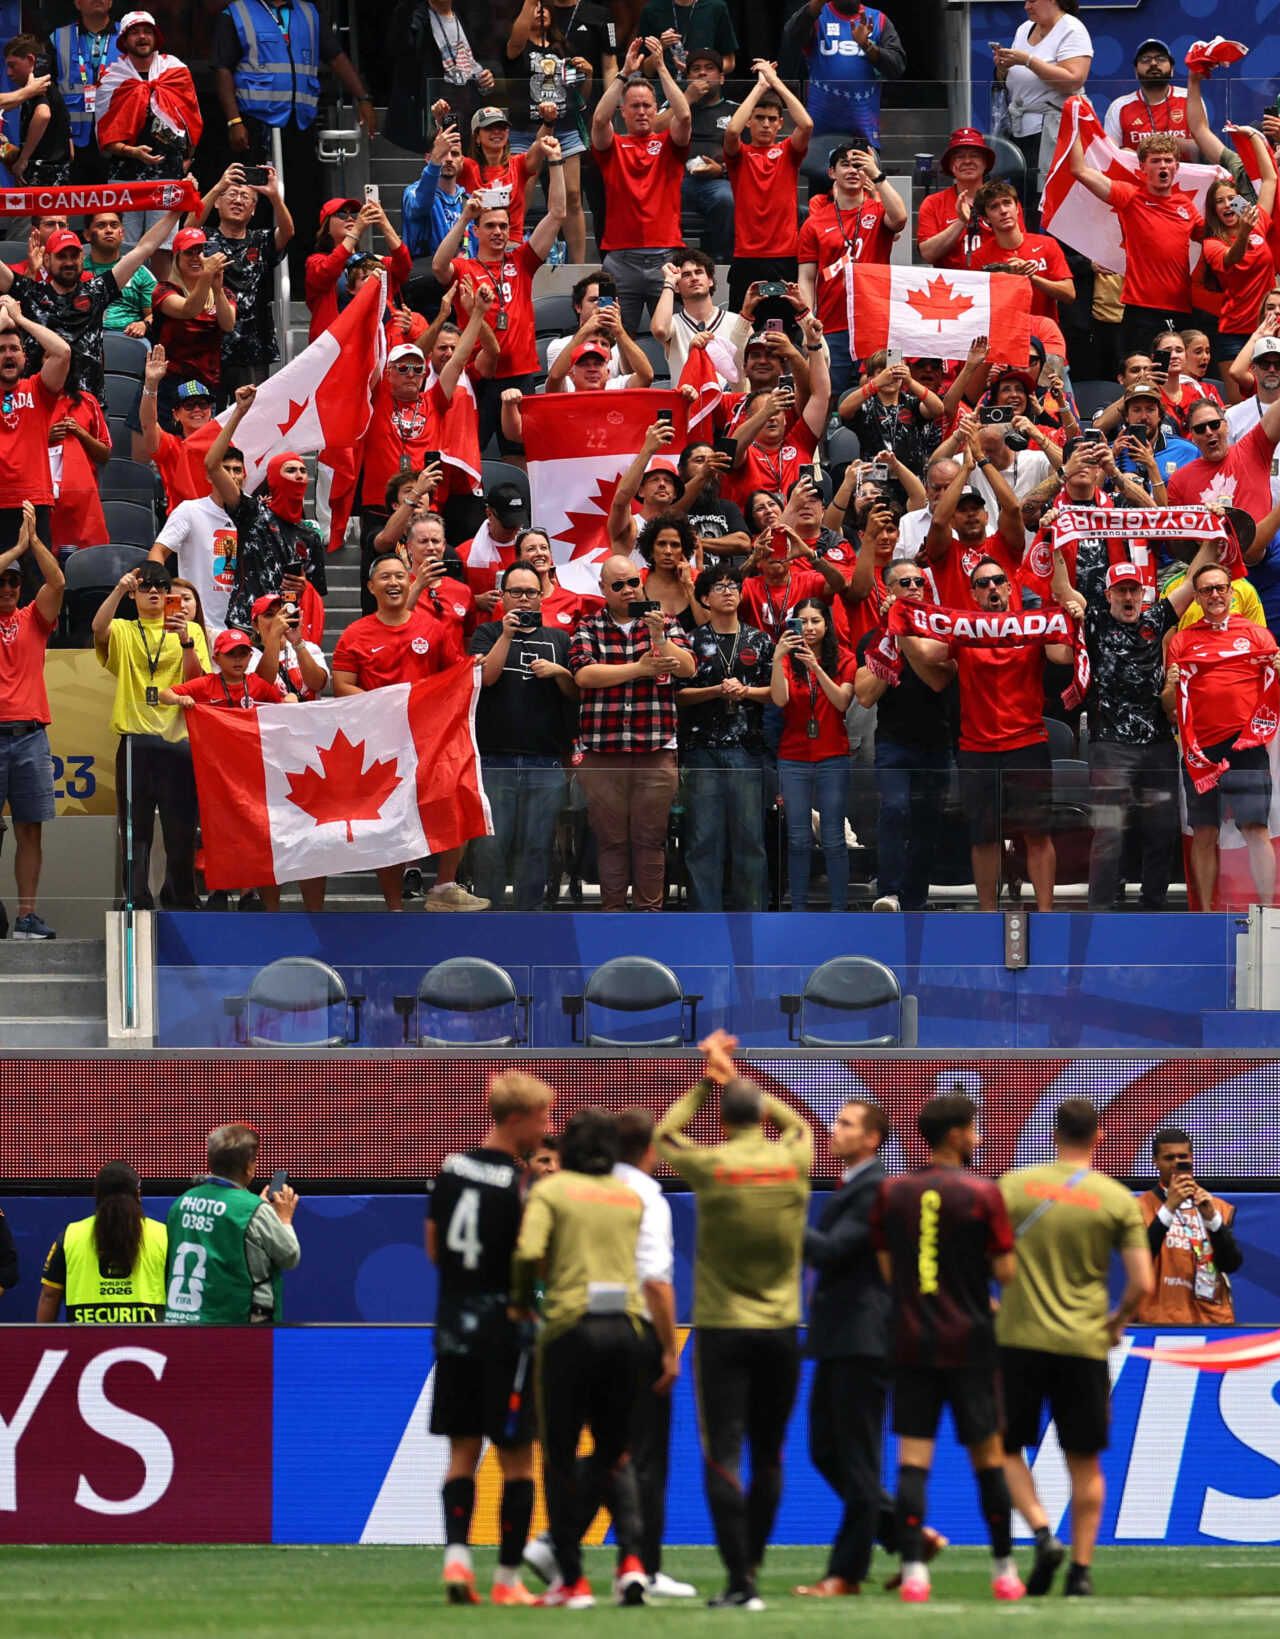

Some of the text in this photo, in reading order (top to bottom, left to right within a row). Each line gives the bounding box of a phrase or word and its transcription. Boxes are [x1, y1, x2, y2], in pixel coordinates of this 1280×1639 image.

[541, 90, 558, 98] FIFA
[38, 189, 134, 209] CANADA
[1057, 512, 1214, 532] VOYAGEURS
[929, 613, 1068, 638] CANADA
[1253, 717, 1276, 727] CANADA
[180, 1196, 226, 1216] PHOTO
[181, 1213, 214, 1232] 0385
[447, 1188, 481, 1269] 4
[100, 1287, 132, 1295] 2026
[175, 1296, 192, 1305] FIFA
[75, 1307, 157, 1323] SECURITY
